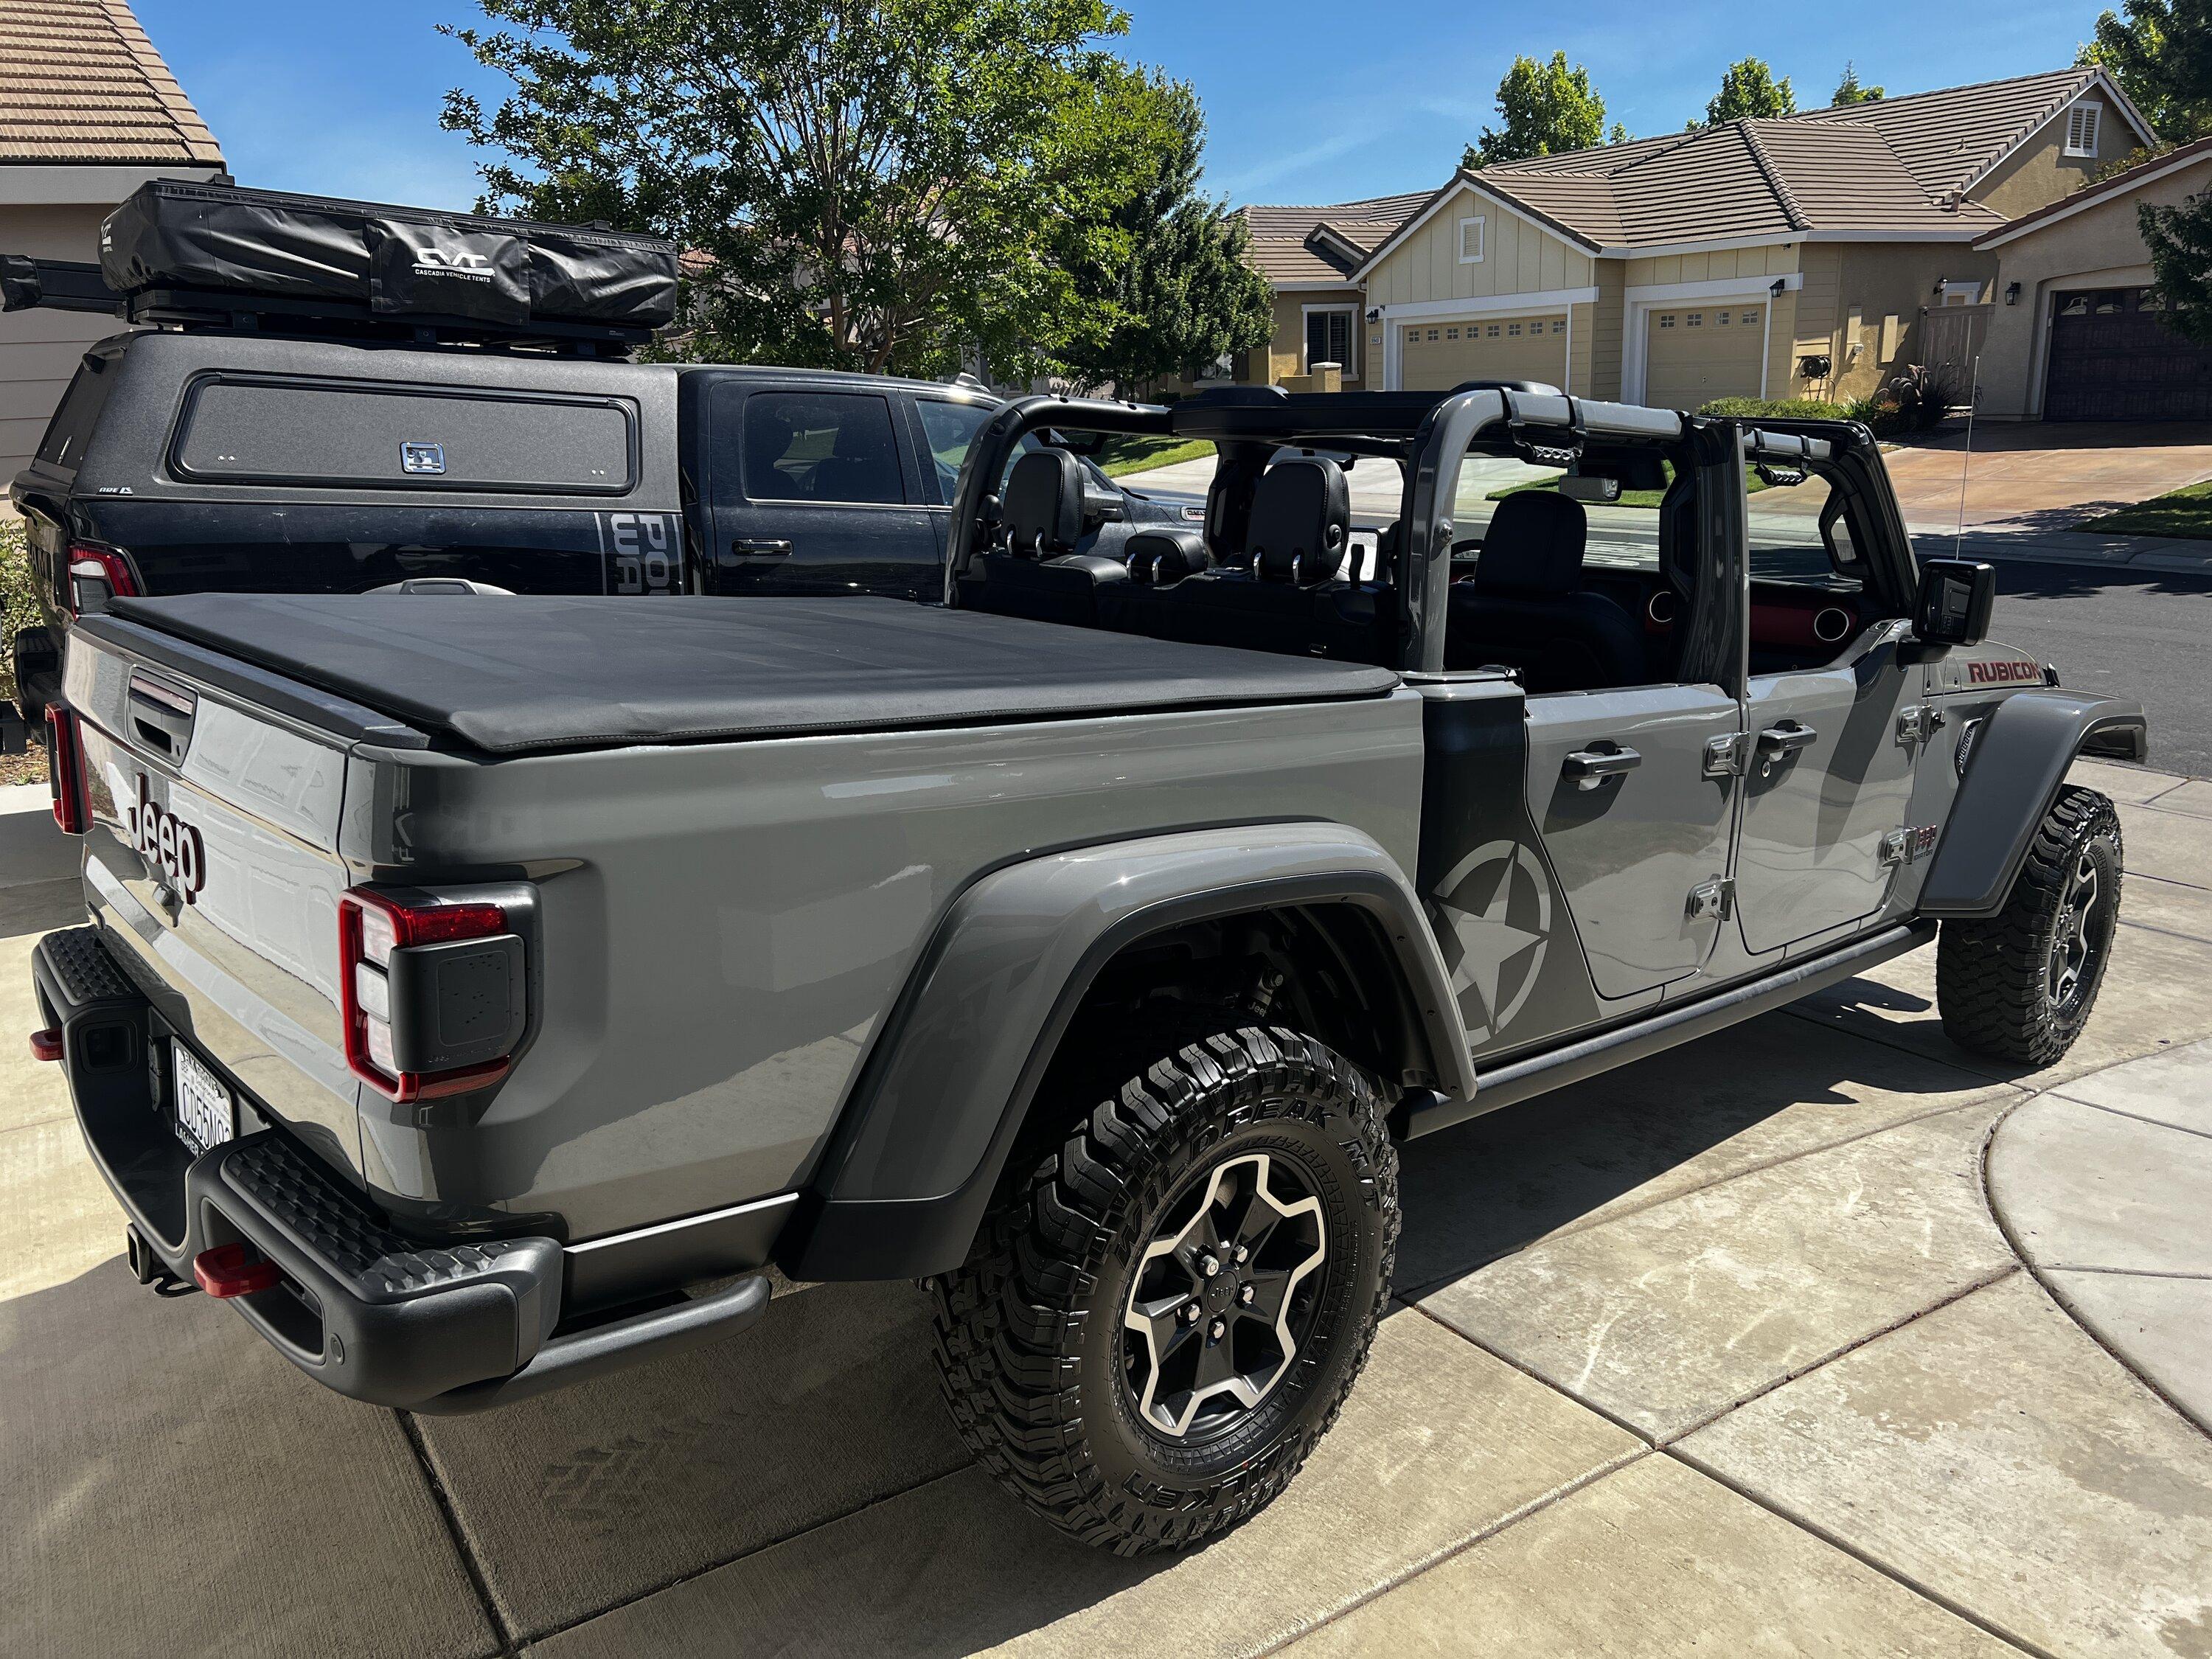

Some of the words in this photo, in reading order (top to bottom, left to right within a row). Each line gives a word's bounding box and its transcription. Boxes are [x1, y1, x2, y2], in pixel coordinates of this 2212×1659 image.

[415, 268, 445, 276] CASCADIA
[446, 271, 471, 280] VEHICLE
[639, 515, 671, 596] PO
[1967, 661, 2042, 683] RUBICON
[128, 772, 206, 905] Jeep
